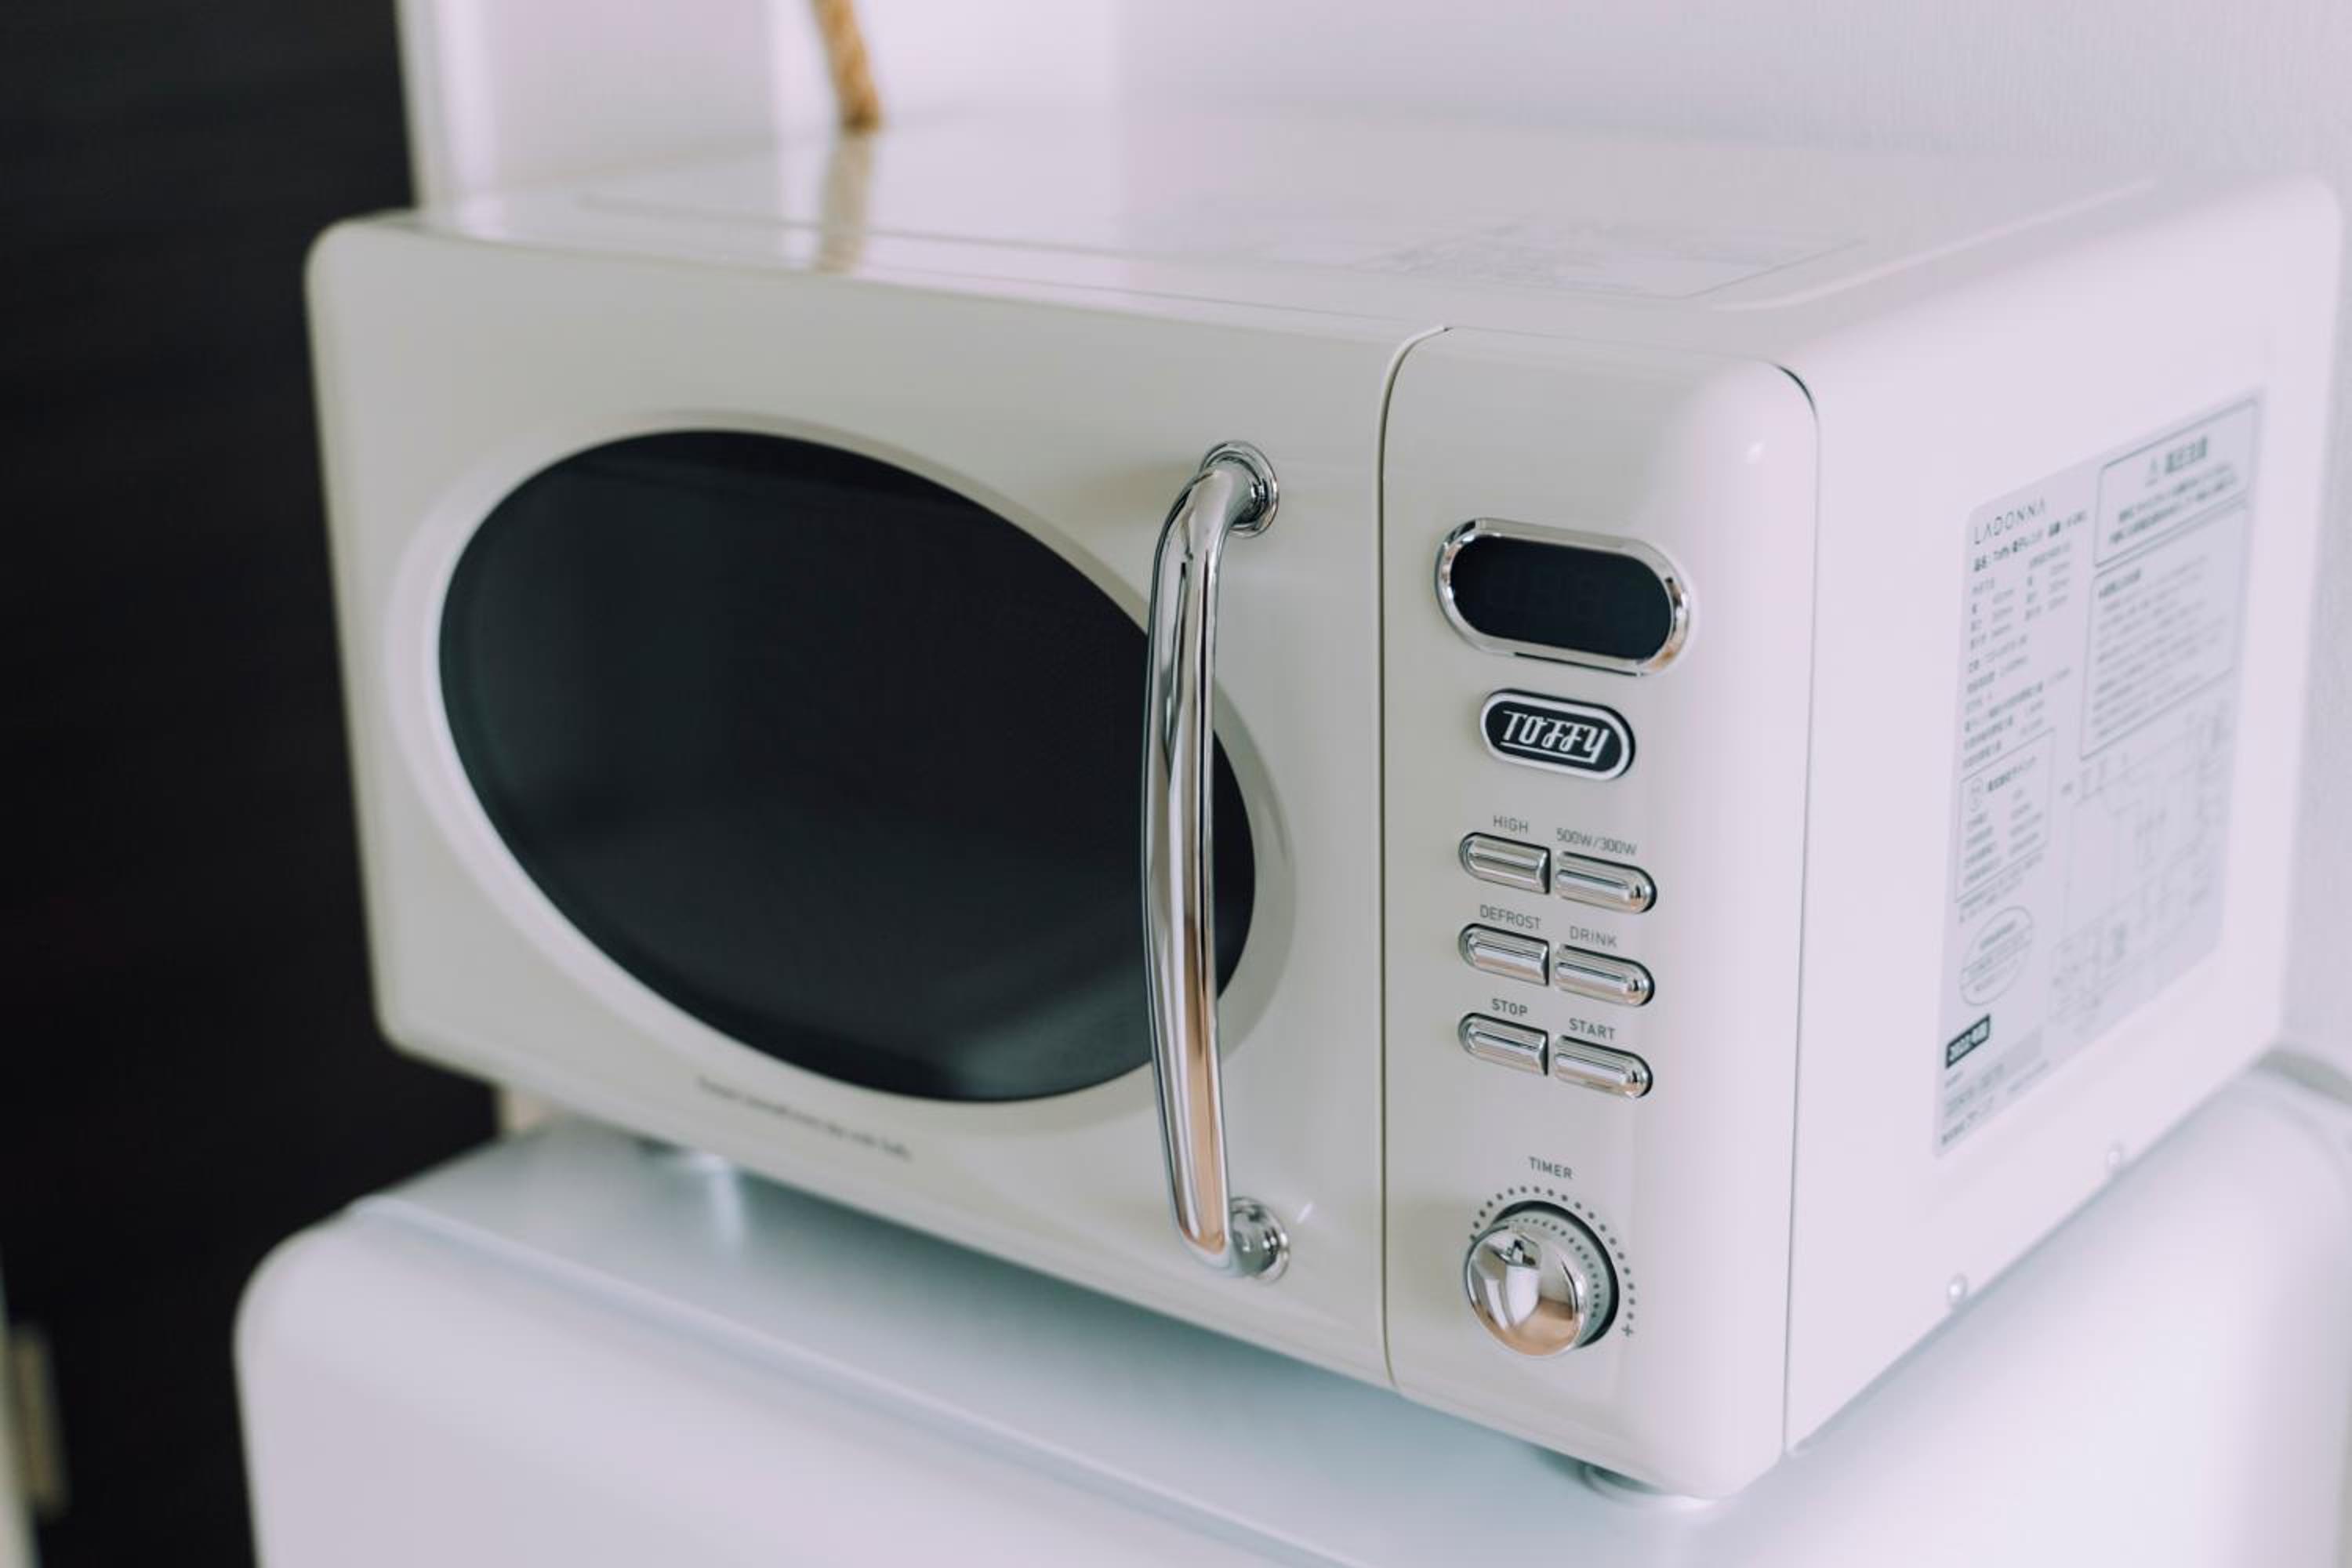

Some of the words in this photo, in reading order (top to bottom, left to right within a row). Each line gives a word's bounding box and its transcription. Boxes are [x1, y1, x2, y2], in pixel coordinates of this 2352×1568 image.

[1493, 815, 1529, 833] HIGH
[1555, 827, 1638, 855] 500W/300W
[1480, 904, 1542, 930] DEFROST
[1570, 926, 1617, 948] DRINK
[1491, 998, 1528, 1017] STOP
[1569, 1018, 1617, 1041] START
[1529, 1156, 1573, 1179] TIMER
